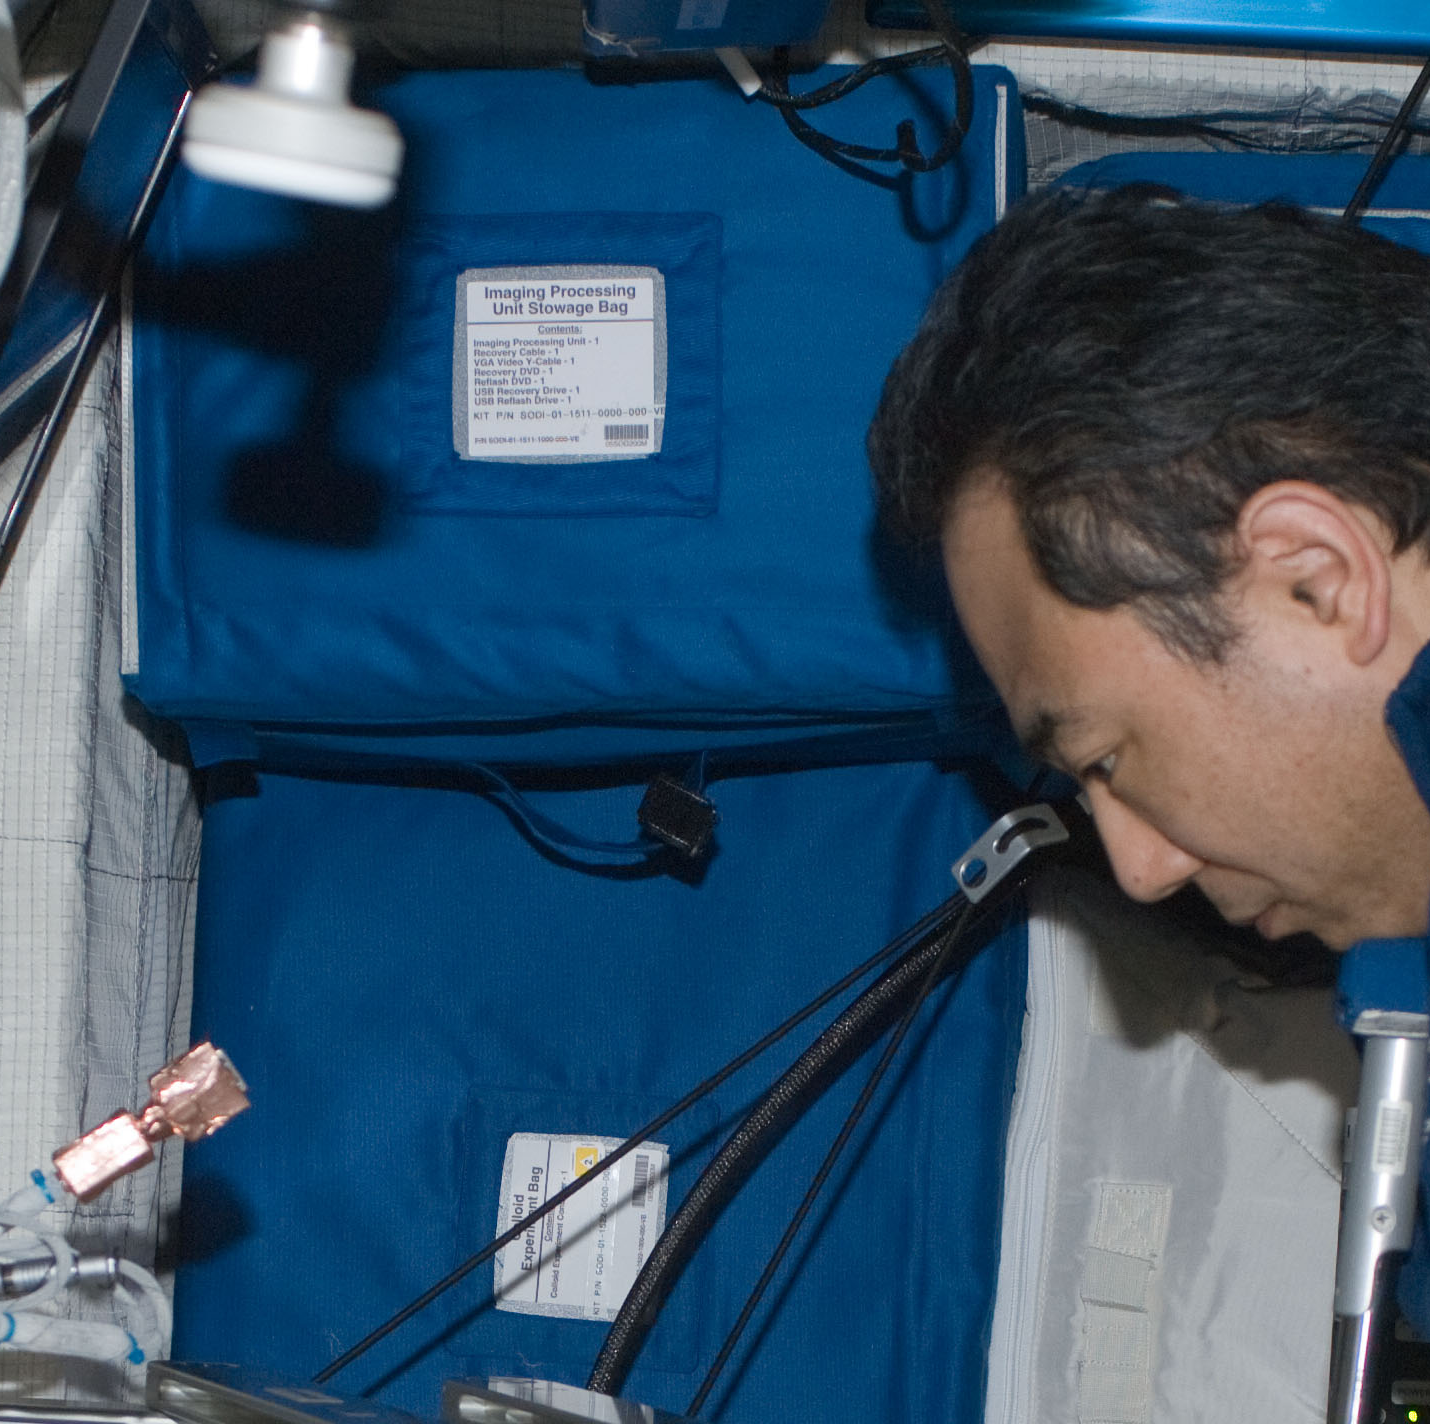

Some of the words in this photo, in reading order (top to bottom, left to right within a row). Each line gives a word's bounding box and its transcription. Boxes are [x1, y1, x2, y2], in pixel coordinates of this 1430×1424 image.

[484, 285, 546, 301] Imaging
[550, 283, 637, 299] Processing
[492, 302, 524, 315] Unit
[528, 301, 595, 316] Stowage
[598, 300, 629, 315] Bag
[537, 324, 583, 335] Contents:
[473, 339, 511, 349] Imaging
[513, 337, 565, 348] Processing
[567, 337, 586, 345] Unit
[473, 349, 517, 358] Recovery
[519, 347, 546, 356] Cable
[473, 358, 495, 367] VGA
[497, 357, 524, 366] Video
[526, 356, 562, 366] Y-Cable
[474, 368, 517, 378] Recovery
[519, 367, 540, 376] DVD
[474, 377, 509, 387] Reflash
[511, 376, 532, 385] DVD
[474, 387, 495, 396] USB
[497, 386, 540, 397] Recovery
[542, 385, 567, 395] Drive
[474, 397, 495, 406] USB
[497, 396, 532, 406] Reflash
[534, 395, 559, 404] Drive
[474, 412, 489, 421] KIT
[496, 412, 514, 420] P/N
[528, 1166, 544, 1192] Bag
[550, 1270, 561, 1299] Colloid
[594, 1280, 603, 1296] P/N
[592, 1302, 600, 1316] KIT
